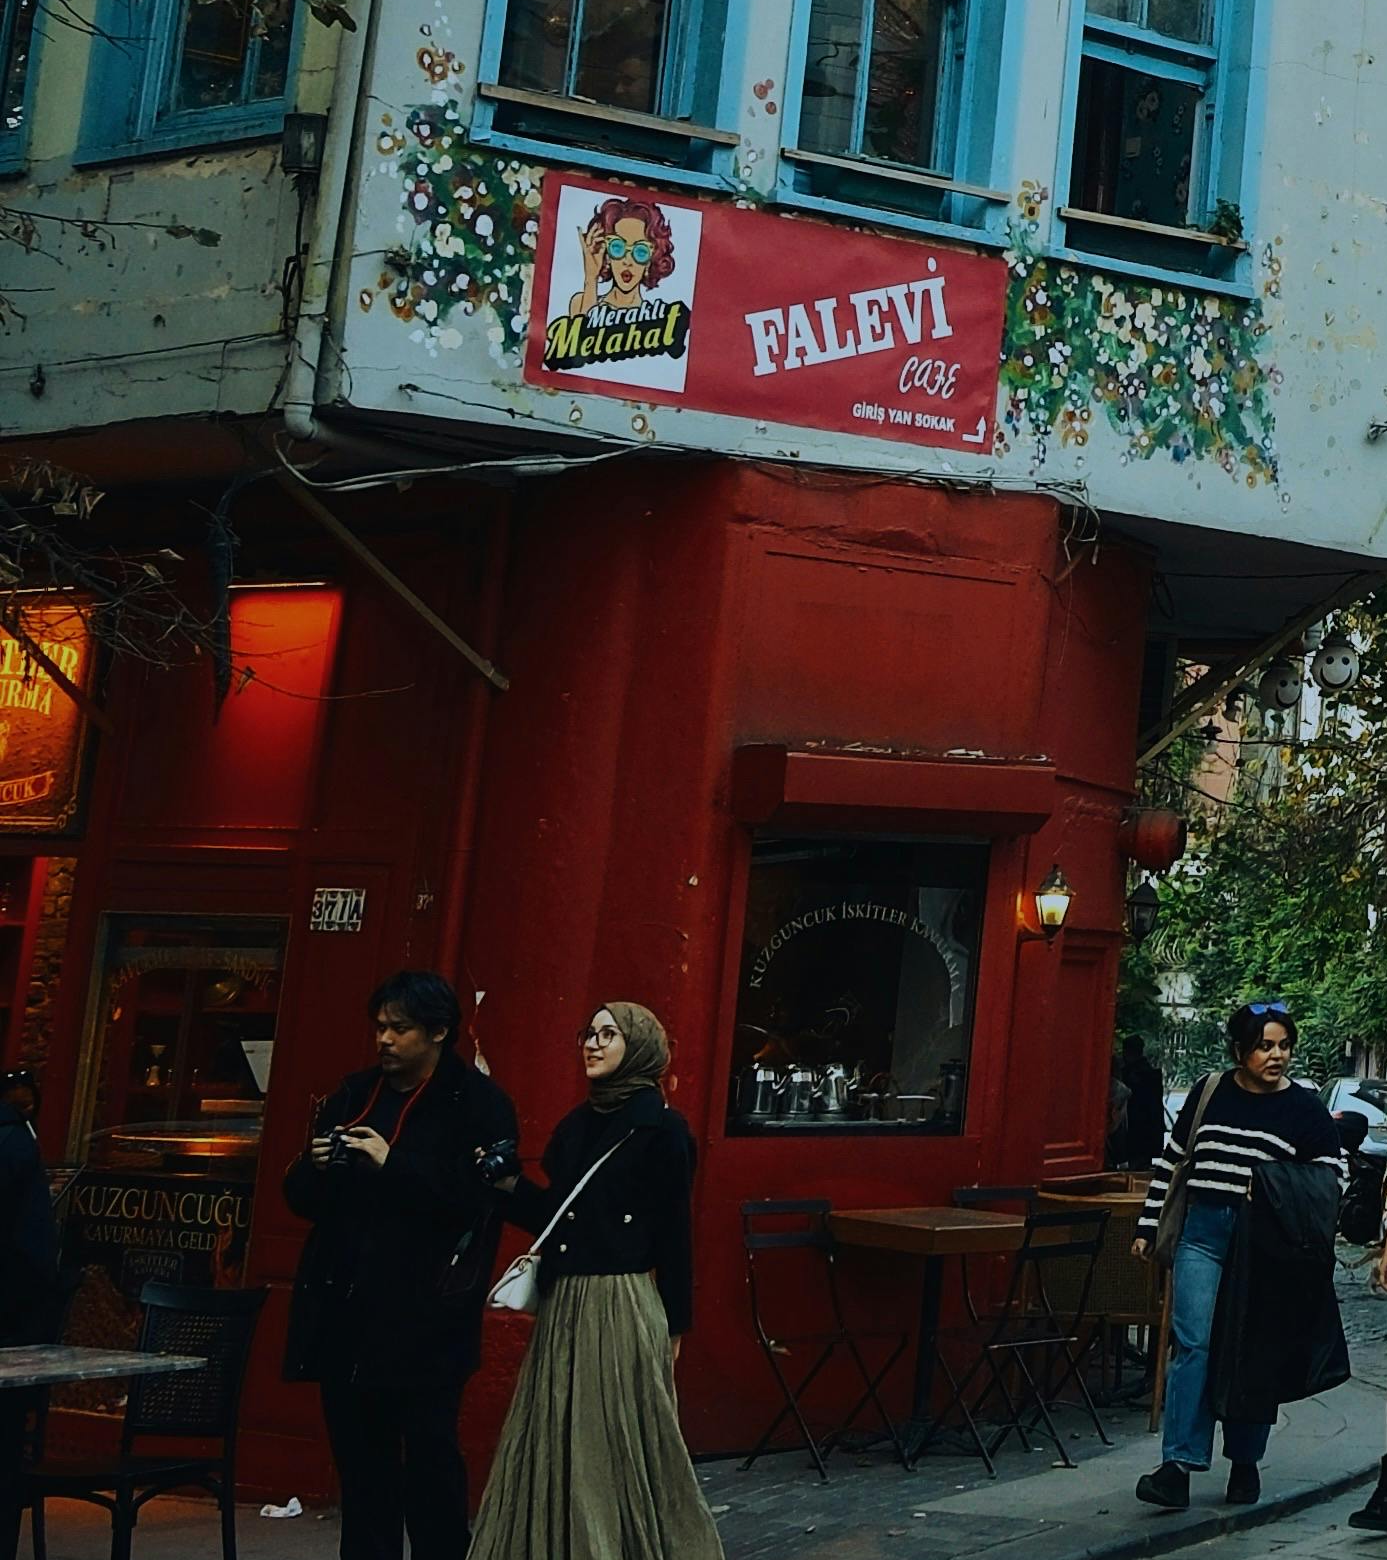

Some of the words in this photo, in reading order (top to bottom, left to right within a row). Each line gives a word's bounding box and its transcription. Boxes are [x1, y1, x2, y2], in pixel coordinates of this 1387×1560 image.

[545, 305, 679, 361] Melahat
[745, 257, 953, 377] FALEVİ
[898, 356, 961, 399] CAFE
[852, 401, 886, 426] GİRİŞ
[888, 408, 913, 426] YAN
[914, 412, 956, 433] SOKAK
[749, 904, 837, 989] KUZGUNCUK
[841, 900, 908, 928] İSKİTLER
[71, 1184, 251, 1228] KUZGUNCUĞU
[85, 1223, 175, 1250] KAVURMAYA
